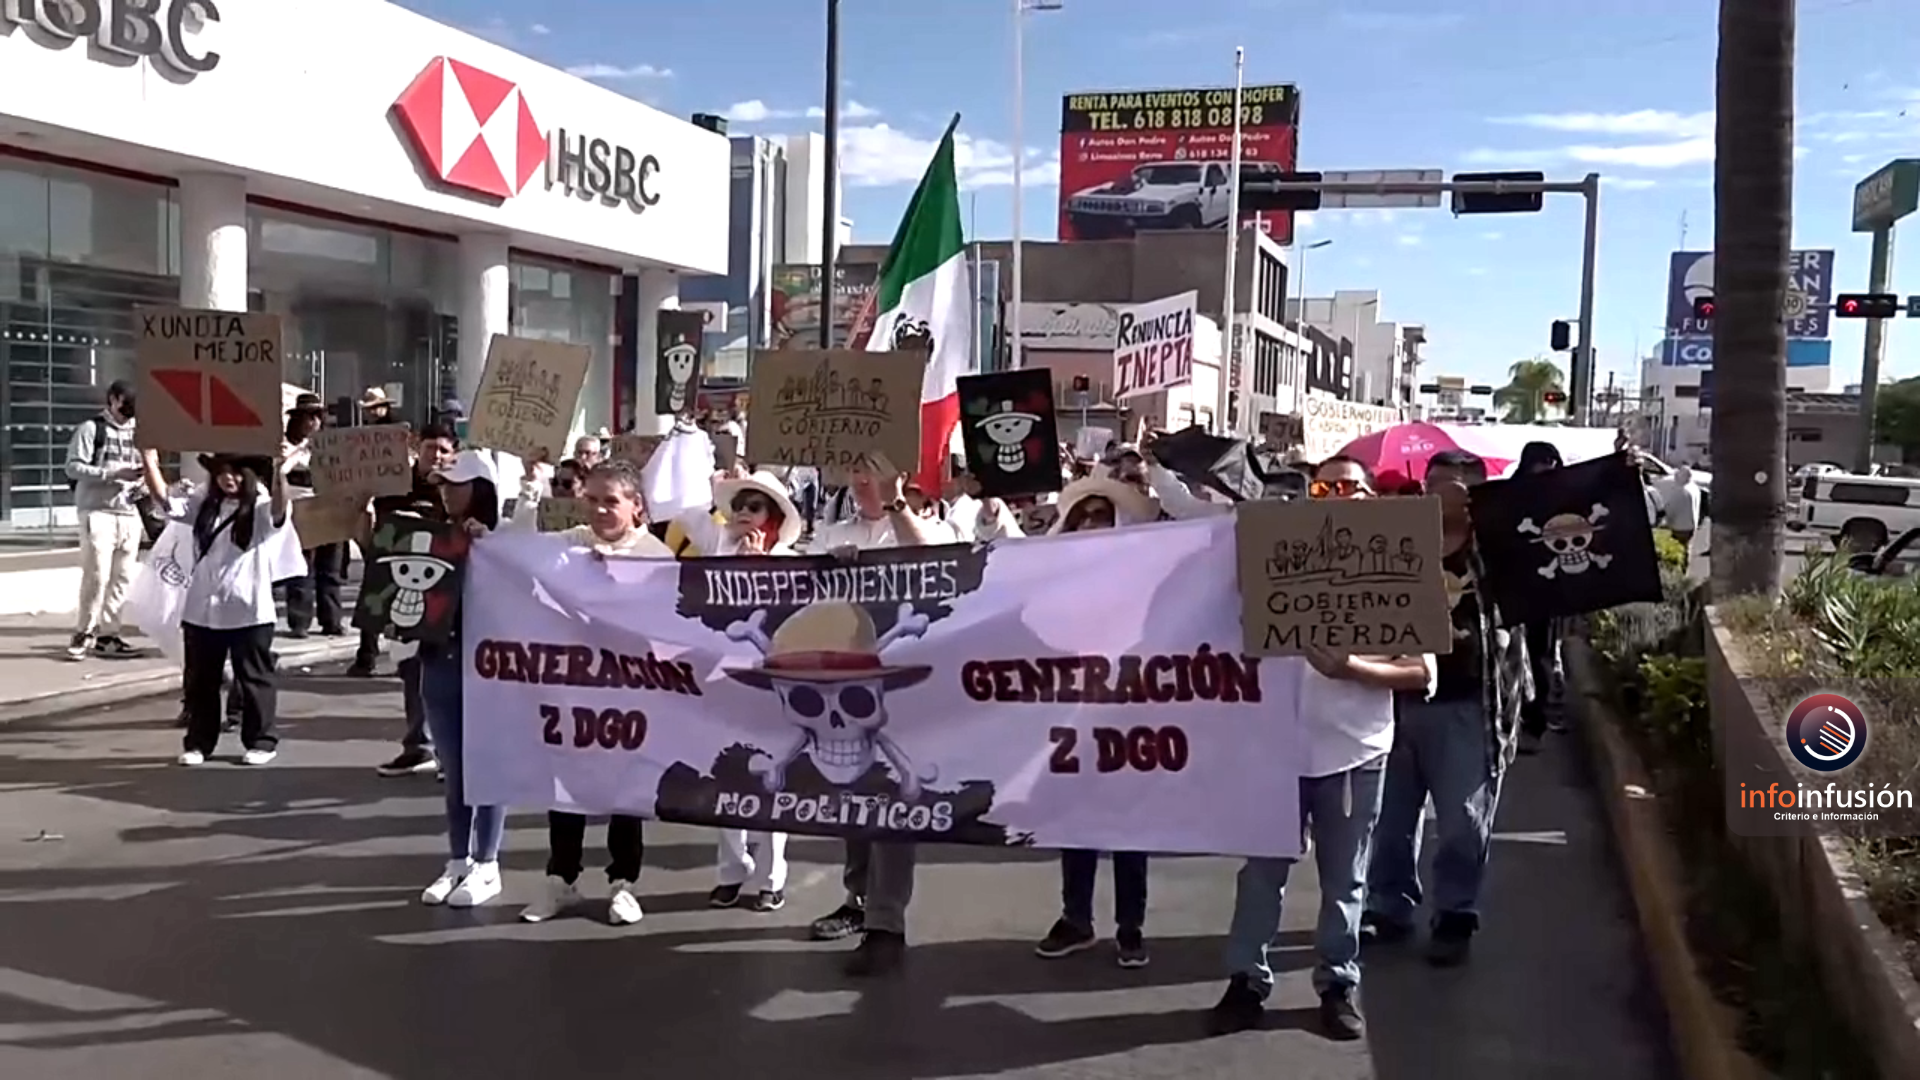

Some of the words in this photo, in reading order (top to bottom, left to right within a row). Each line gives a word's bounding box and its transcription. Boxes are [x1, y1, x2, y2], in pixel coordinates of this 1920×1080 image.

[0, 0, 221, 74] BC
[1069, 95, 1109, 111] RENTA
[1110, 92, 1143, 109] PARA
[1145, 90, 1200, 107] EVENTOS
[1205, 89, 1233, 105] CON
[1240, 87, 1284, 103] HOFER
[1089, 112, 1129, 130] TEL.
[1134, 109, 1165, 128] 618
[1171, 107, 1203, 127] 818
[1208, 106, 1232, 126] 08
[1241, 105, 1263, 125] 98
[556, 126, 661, 207] HSBC
[1117, 307, 1192, 348] RENUNCIA
[194, 339, 274, 364] MEJOR
[1114, 337, 1192, 398] INEPTA
[779, 416, 881, 438] GOBIERNO
[809, 436, 836, 449] DE
[704, 560, 958, 607] INDEPENDIENTES
[1266, 590, 1412, 616] GOBIERNO
[1320, 611, 1357, 625] DE
[1263, 622, 1423, 650] MIERDA
[474, 638, 704, 697] GENERACIÓN
[961, 642, 1263, 704] GENERACIÓN
[571, 705, 648, 751] DGO
[1092, 725, 1189, 773] DGO
[714, 791, 761, 819] NO
